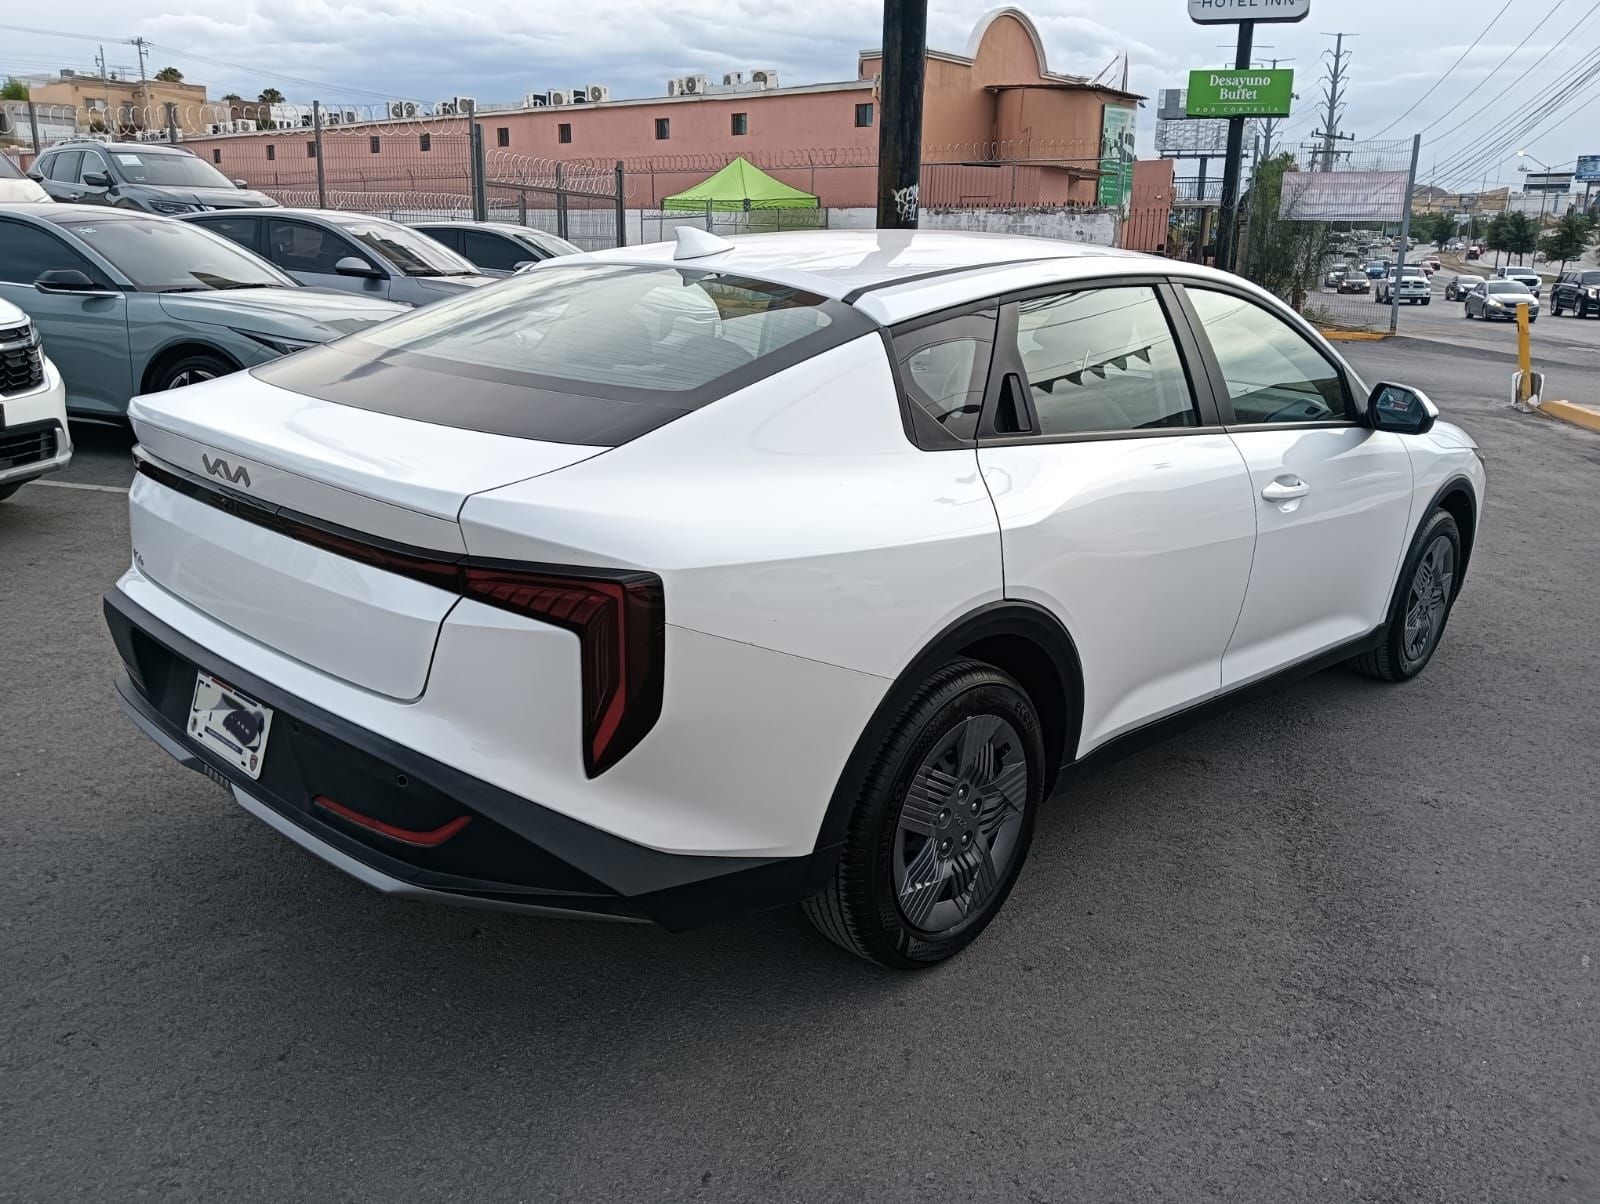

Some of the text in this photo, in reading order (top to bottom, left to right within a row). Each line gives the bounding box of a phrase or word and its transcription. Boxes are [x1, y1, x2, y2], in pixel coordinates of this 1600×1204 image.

[1201, 0, 1258, 8] HOTEL
[1209, 74, 1271, 88] Desayuno
[1219, 87, 1257, 100] Buffet
[202, 453, 251, 488] KIA
